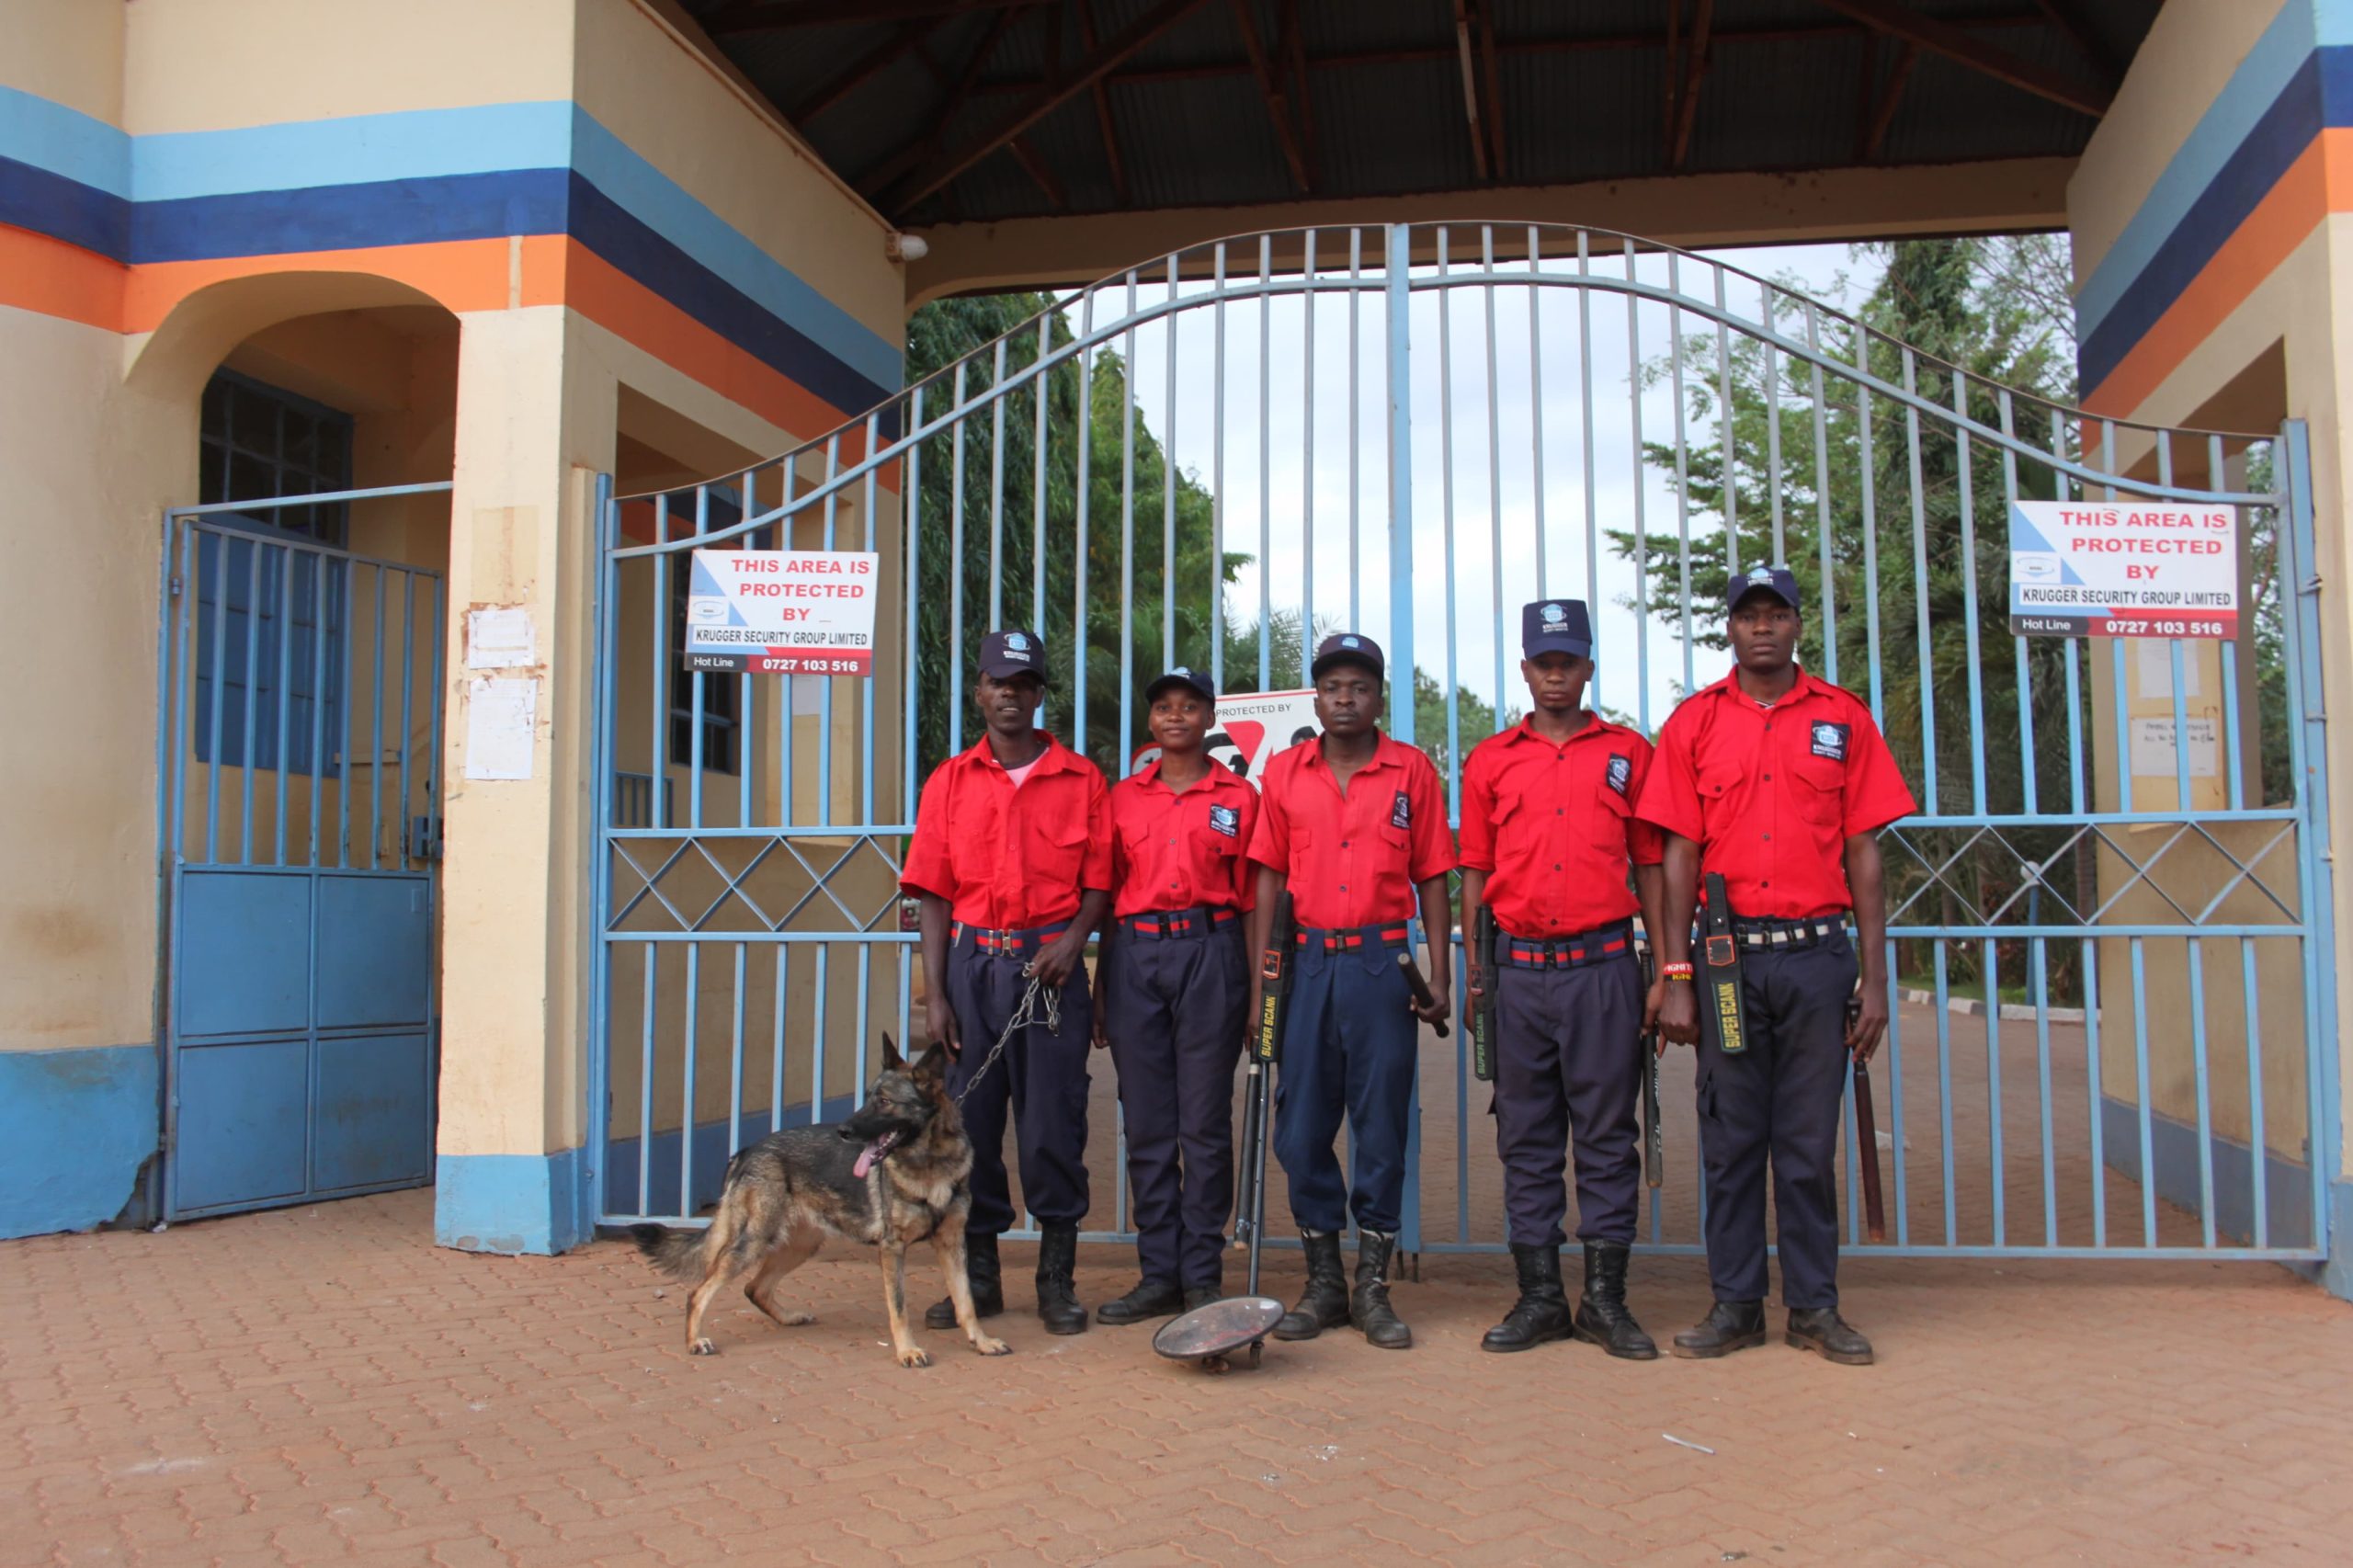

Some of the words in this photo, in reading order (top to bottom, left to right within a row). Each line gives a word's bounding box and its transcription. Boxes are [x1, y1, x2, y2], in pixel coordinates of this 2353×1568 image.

[2059, 511, 2118, 527] THIS
[2126, 513, 2194, 528] AREA
[2203, 514, 2227, 528] IS
[2072, 538, 2222, 554] PROTECTED
[732, 559, 779, 573] THIS
[786, 560, 842, 574] AREA
[850, 561, 870, 574] IS
[2126, 564, 2159, 579] BY
[739, 583, 864, 598] PROTECTED
[2023, 588, 2077, 603] KRUGGER
[2082, 589, 2138, 604] SECURITY
[2142, 591, 2180, 605] GROUP
[2185, 592, 2231, 606] LIMITED
[783, 608, 811, 620] BY
[2022, 619, 2043, 630] Hot
[2046, 619, 2071, 631] Line
[2106, 620, 2148, 634] 0727
[2154, 621, 2185, 635] 103
[2190, 622, 2222, 635] 516
[696, 629, 742, 642] KRUGGER
[744, 631, 790, 643] SECURITY
[793, 631, 826, 644] GROUP
[829, 632, 868, 645] LIMITED
[694, 657, 711, 667] Hot
[713, 658, 733, 667] Line
[762, 659, 797, 670] 0727
[801, 660, 828, 671] 103
[832, 661, 858, 672] 516
[1215, 704, 1276, 717] PROTECTED
[1278, 703, 1291, 711] BY
[1722, 1016, 1741, 1048] SUPER
[1261, 1027, 1273, 1057] SUPER
